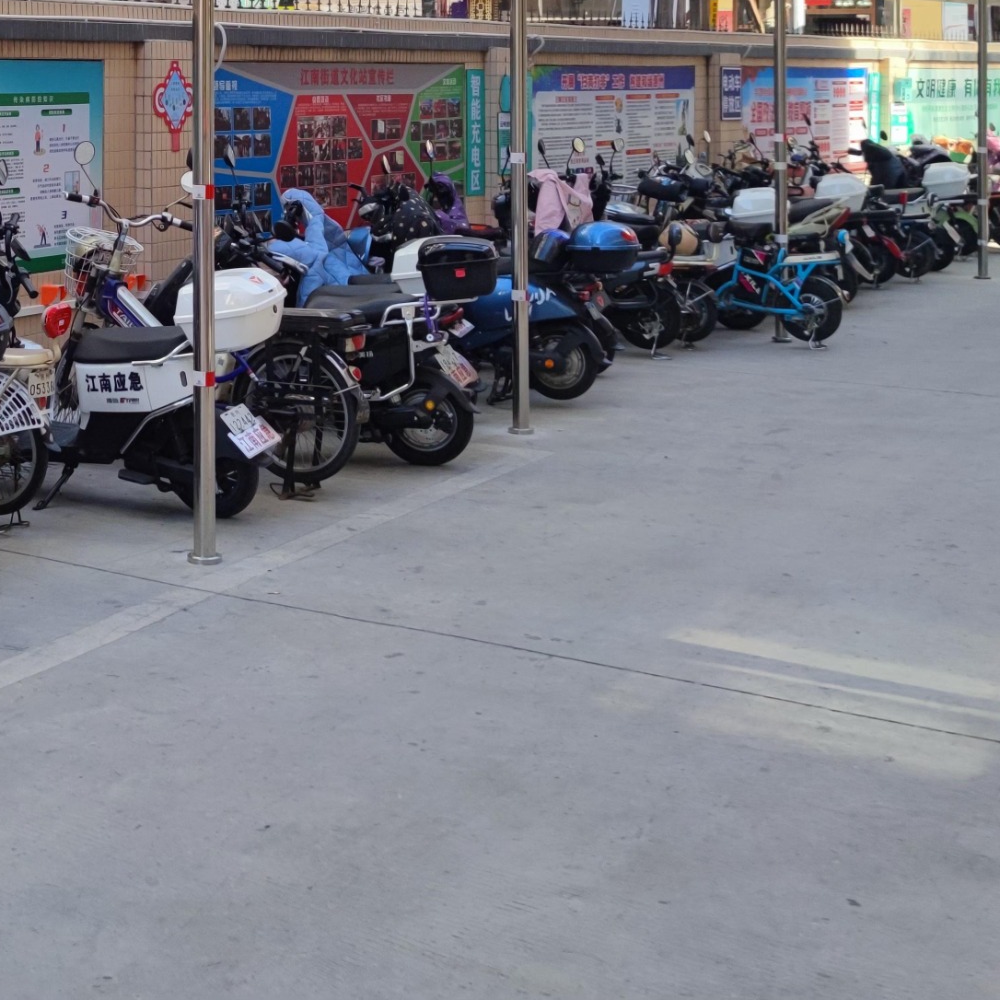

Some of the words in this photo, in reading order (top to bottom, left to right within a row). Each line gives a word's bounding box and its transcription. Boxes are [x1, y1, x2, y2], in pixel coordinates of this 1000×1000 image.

[300, 67, 395, 87] 江南街道文化站宣传栏
[916, 78, 957, 98] 文明健康
[470, 74, 482, 191] 智能充电区
[42, 163, 50, 173] 2
[60, 210, 68, 220] 3
[85, 371, 144, 393] 江南应急
